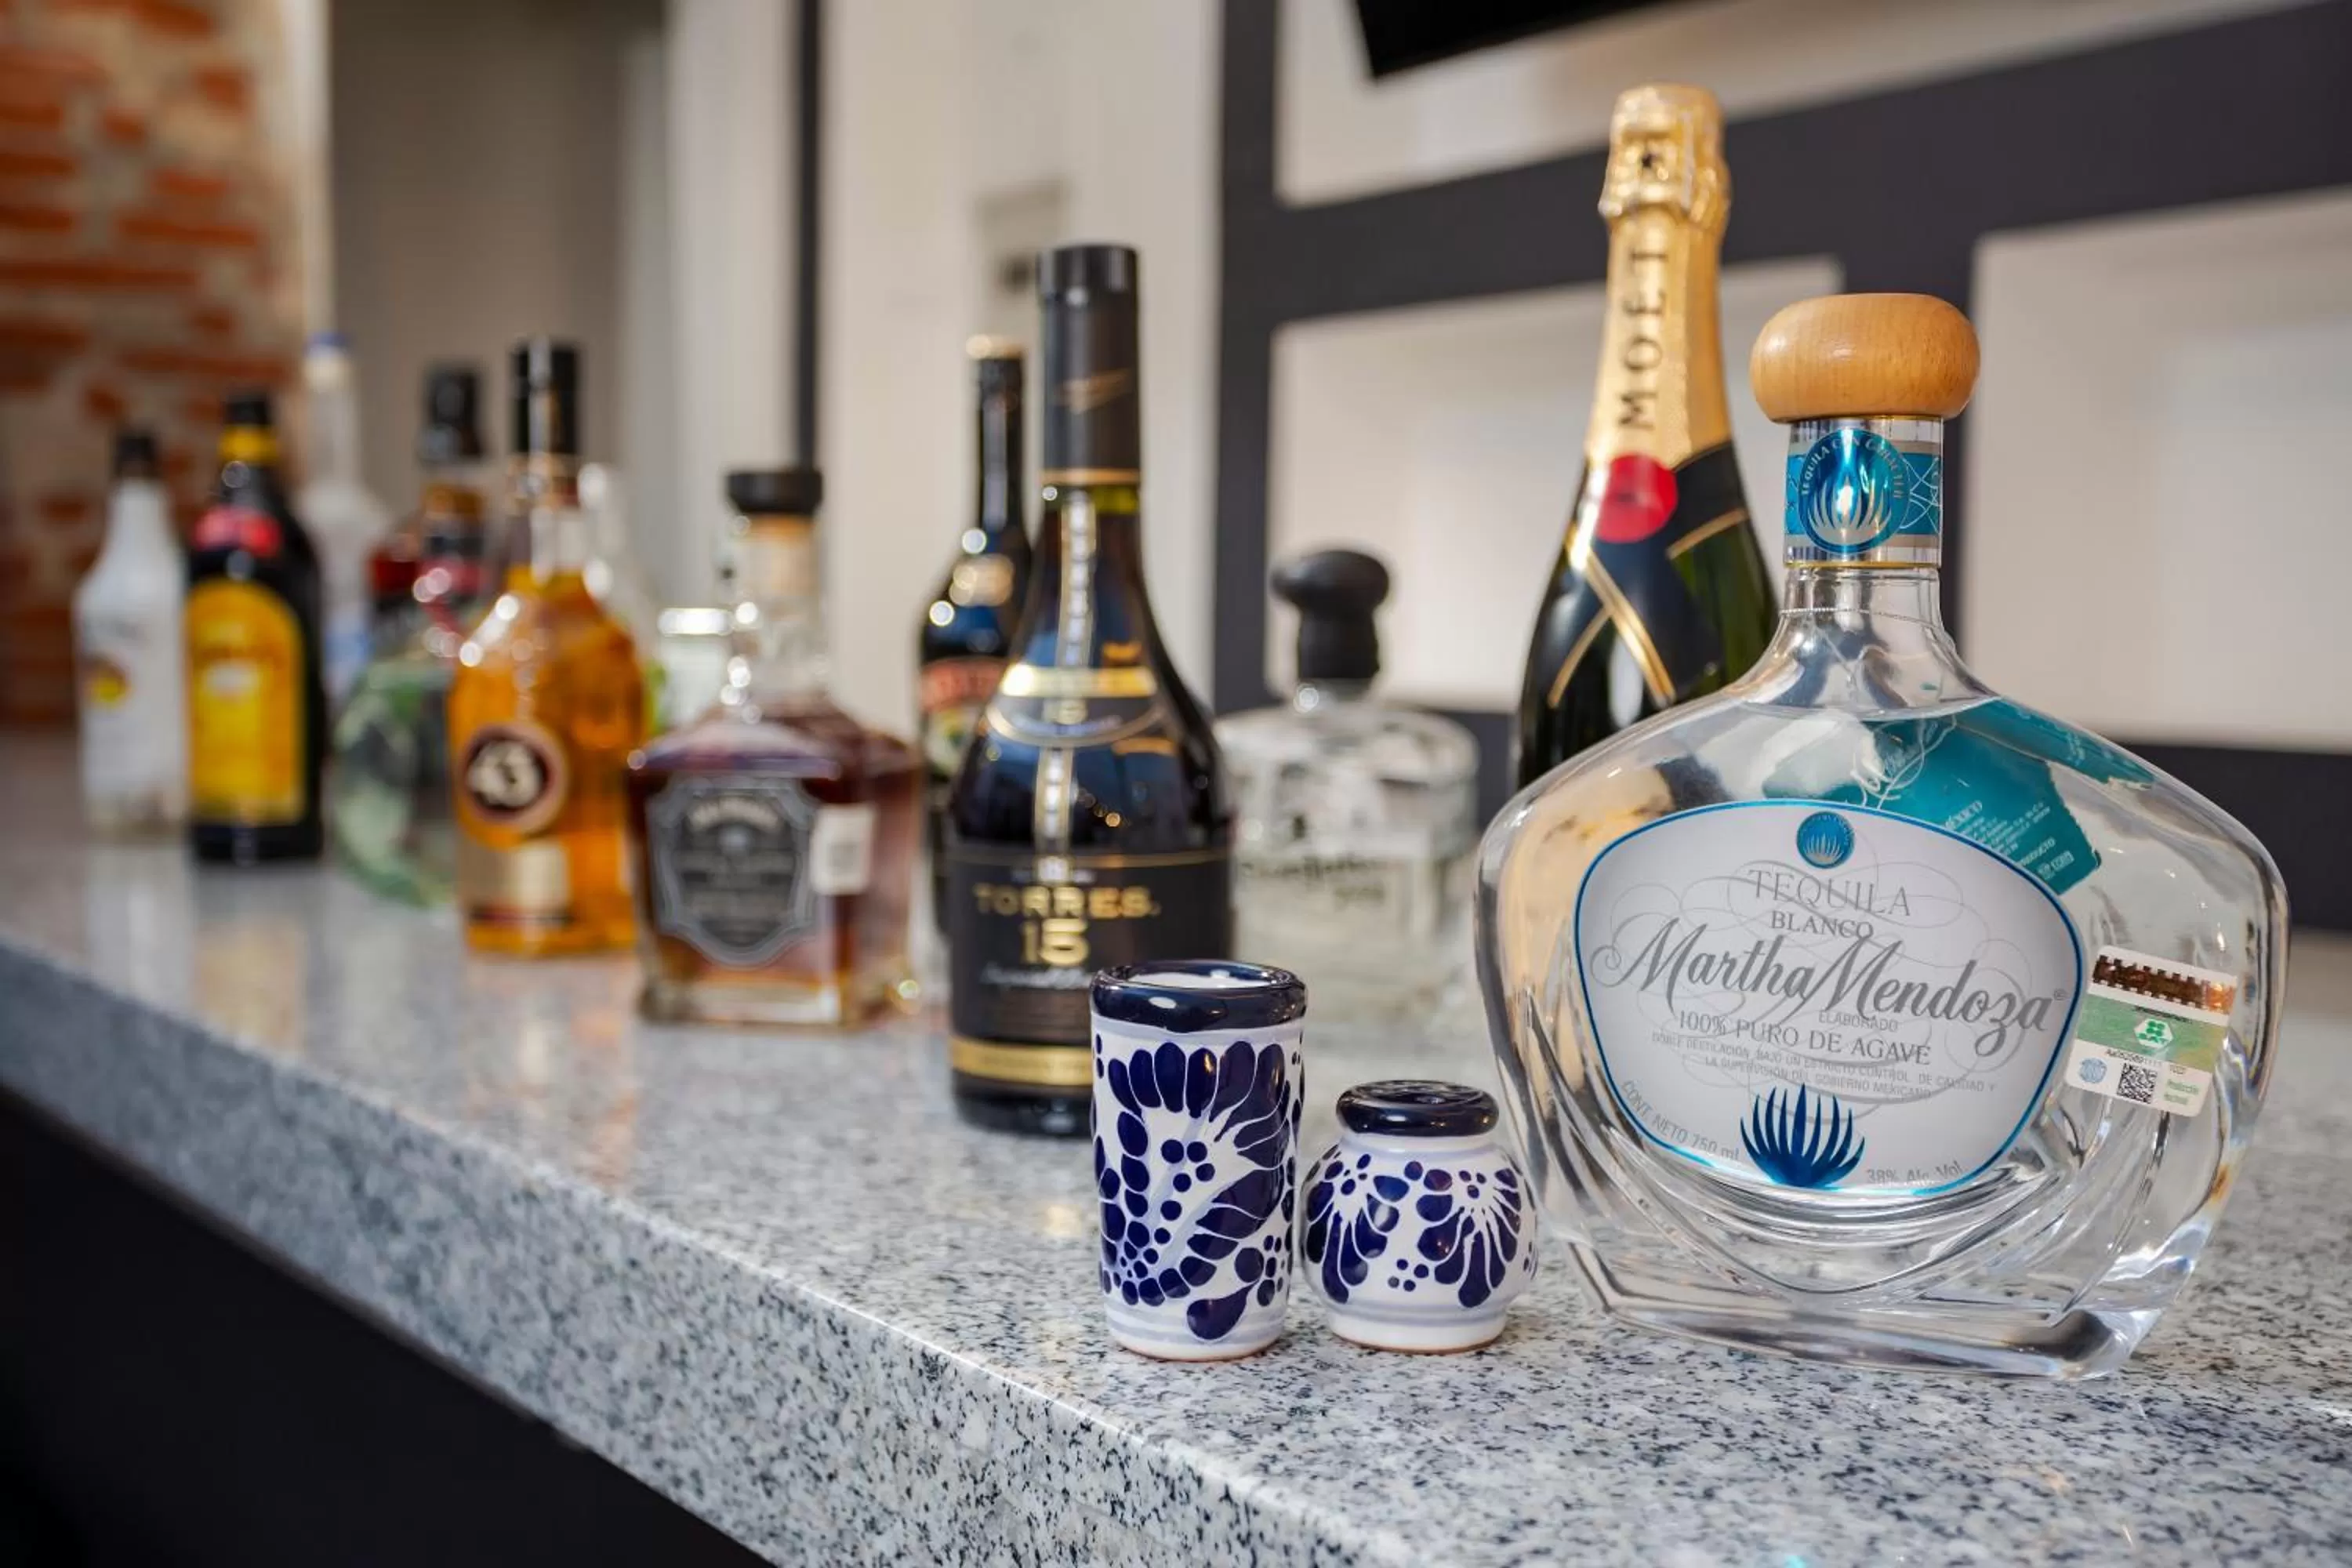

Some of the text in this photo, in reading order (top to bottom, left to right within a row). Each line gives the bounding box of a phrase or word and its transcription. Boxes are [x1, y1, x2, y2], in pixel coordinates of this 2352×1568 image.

[1802, 446, 1830, 495] TEQUILA
[1748, 869, 1910, 916] TEQUILA
[1022, 918, 1089, 965] 15
[1771, 910, 1874, 939] BLANCO
[1590, 913, 2053, 1058] Martha Mendoza
[1679, 1010, 1932, 1065] 100% PURO DE AGAVE
[1818, 1011, 1899, 1032] ELABORADO
